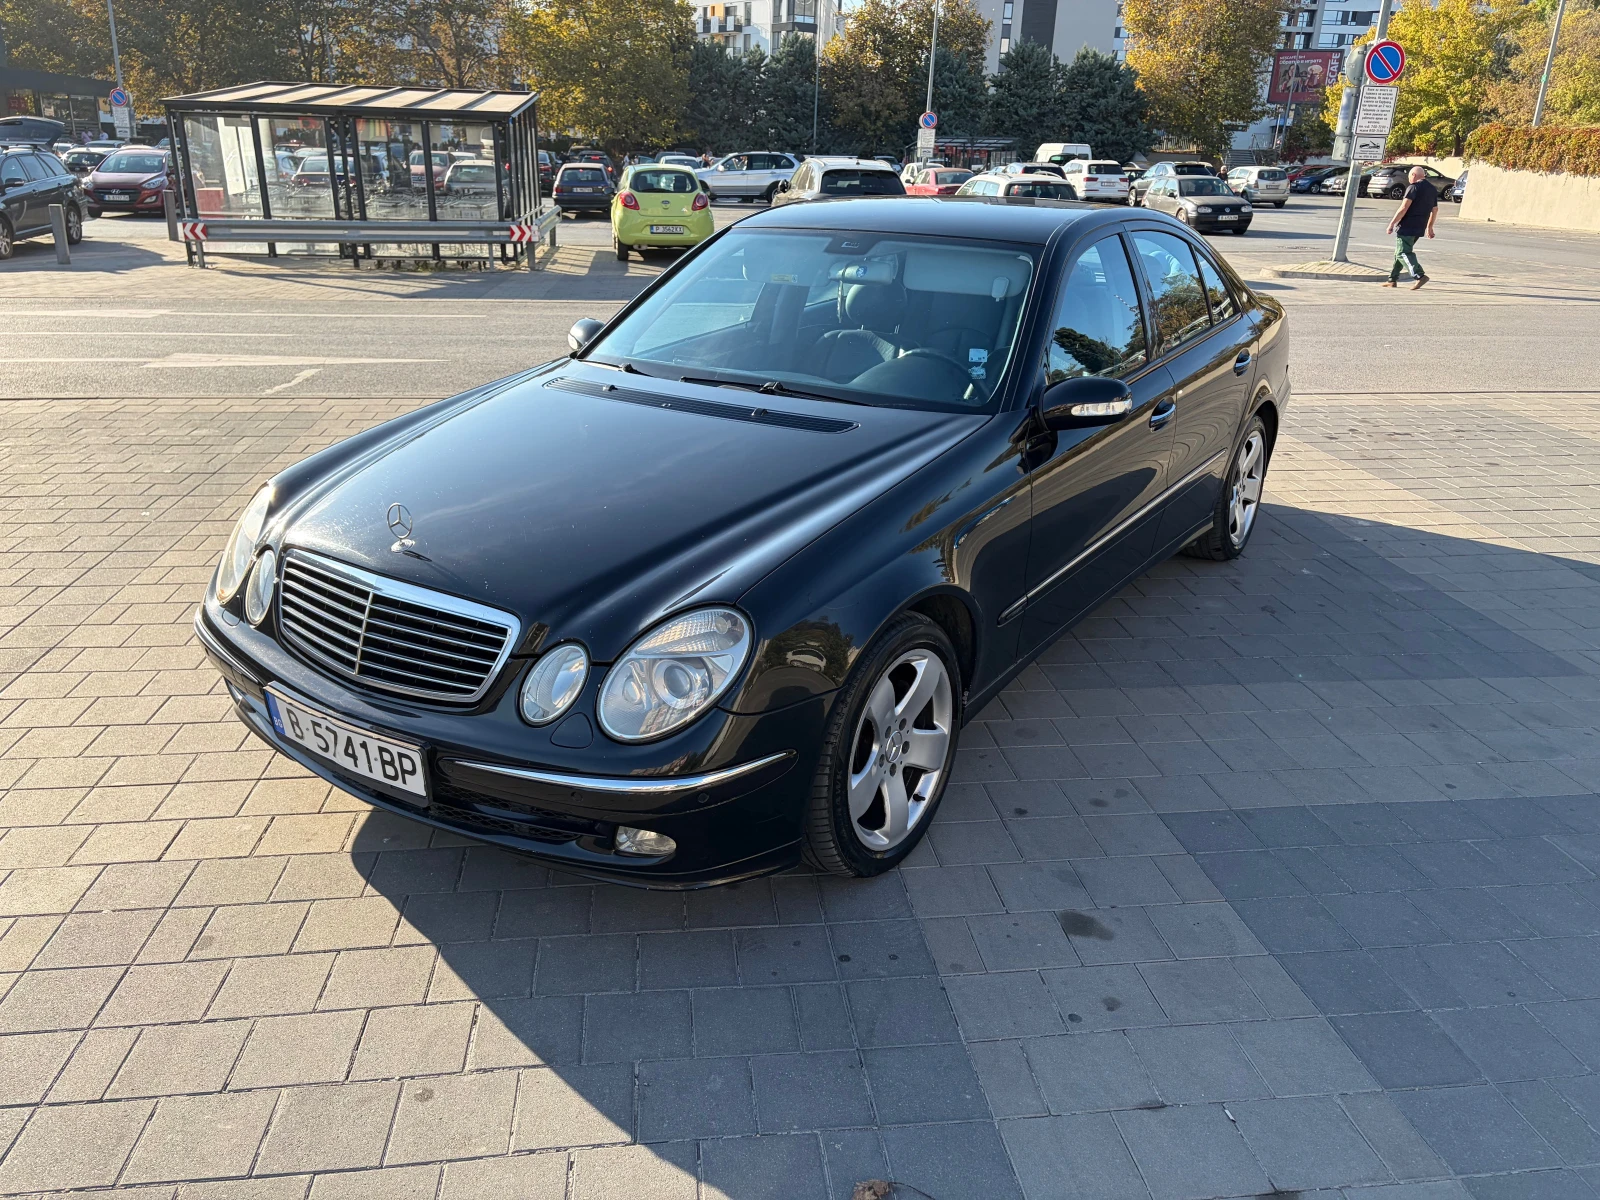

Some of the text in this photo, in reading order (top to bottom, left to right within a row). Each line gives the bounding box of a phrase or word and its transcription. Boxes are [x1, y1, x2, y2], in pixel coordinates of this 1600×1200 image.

[273, 717, 283, 729] BG
[286, 707, 417, 785] B 5741 BP
